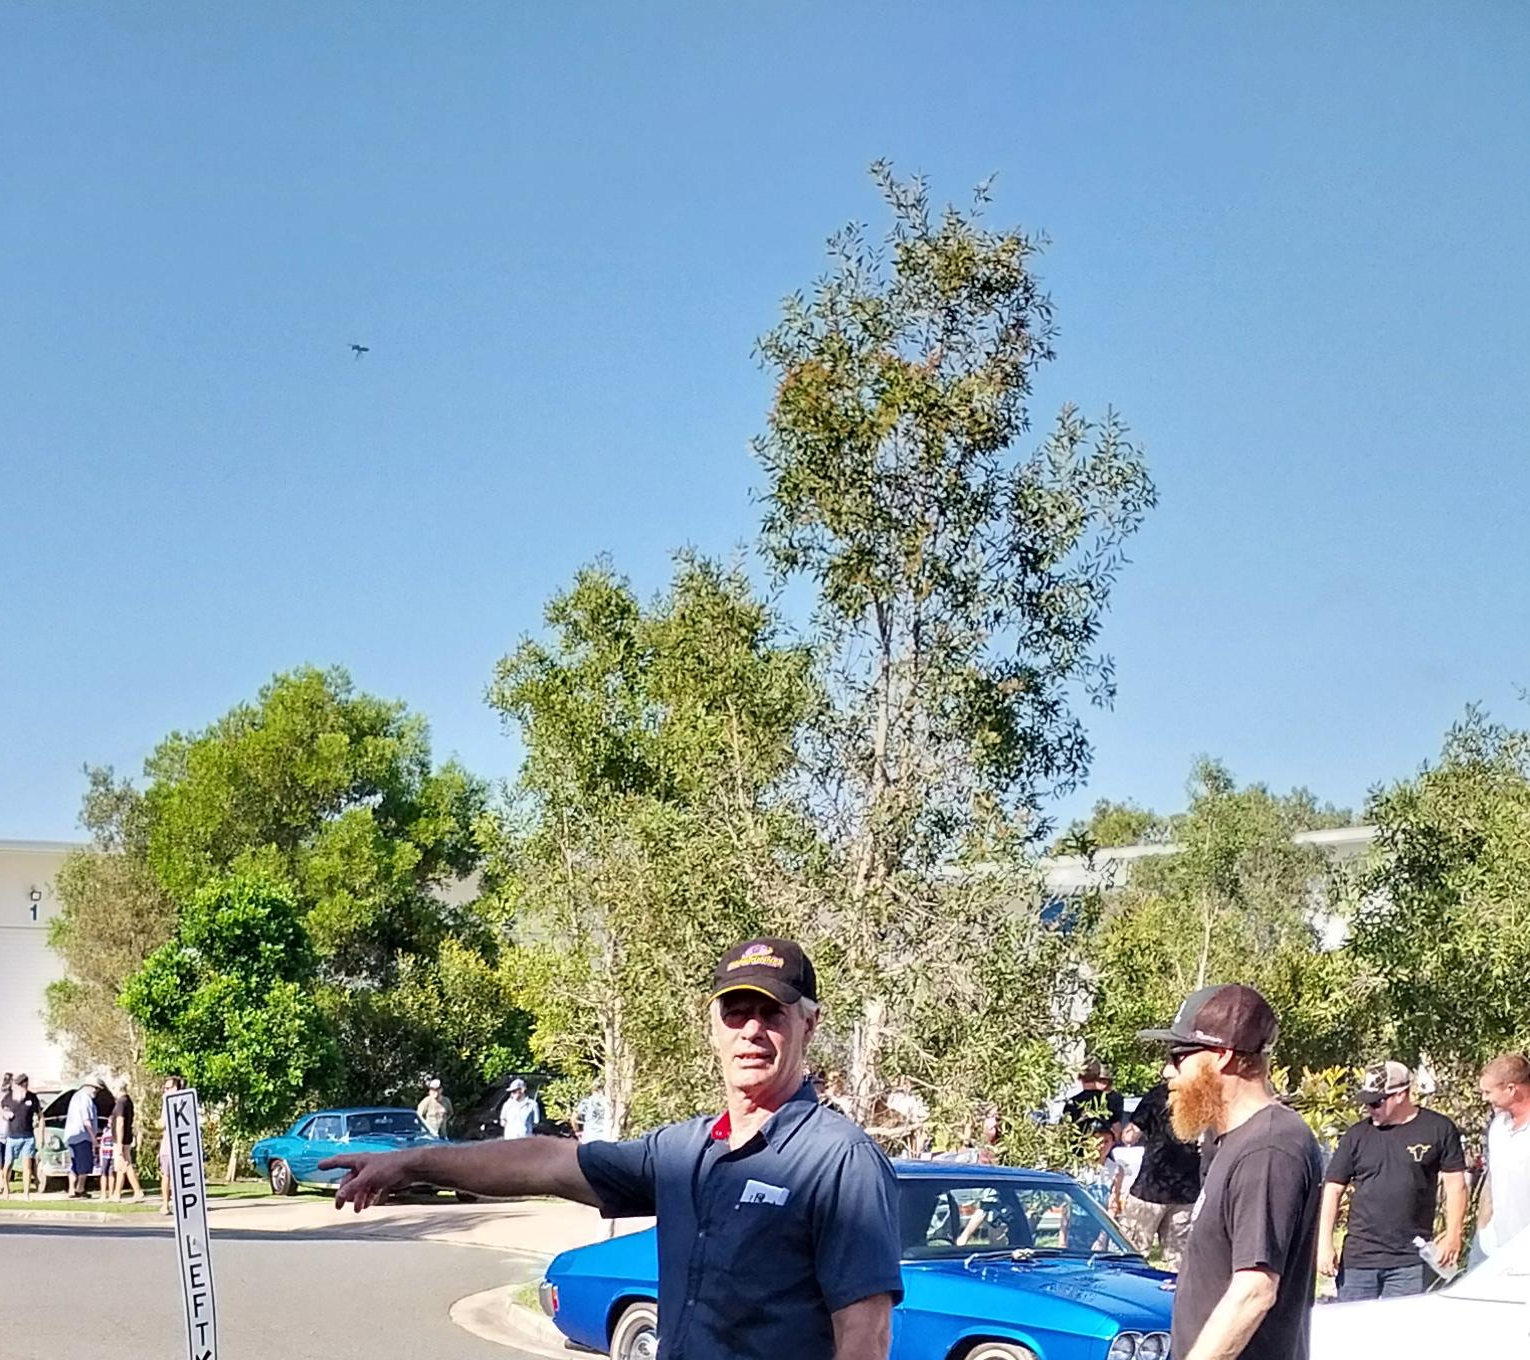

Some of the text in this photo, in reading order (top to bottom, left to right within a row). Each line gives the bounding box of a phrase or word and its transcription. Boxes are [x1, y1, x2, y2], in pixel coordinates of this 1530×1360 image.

[30, 904, 37, 920] 1
[173, 1100, 198, 1219] KEEP
[186, 1234, 209, 1347] LEFT
